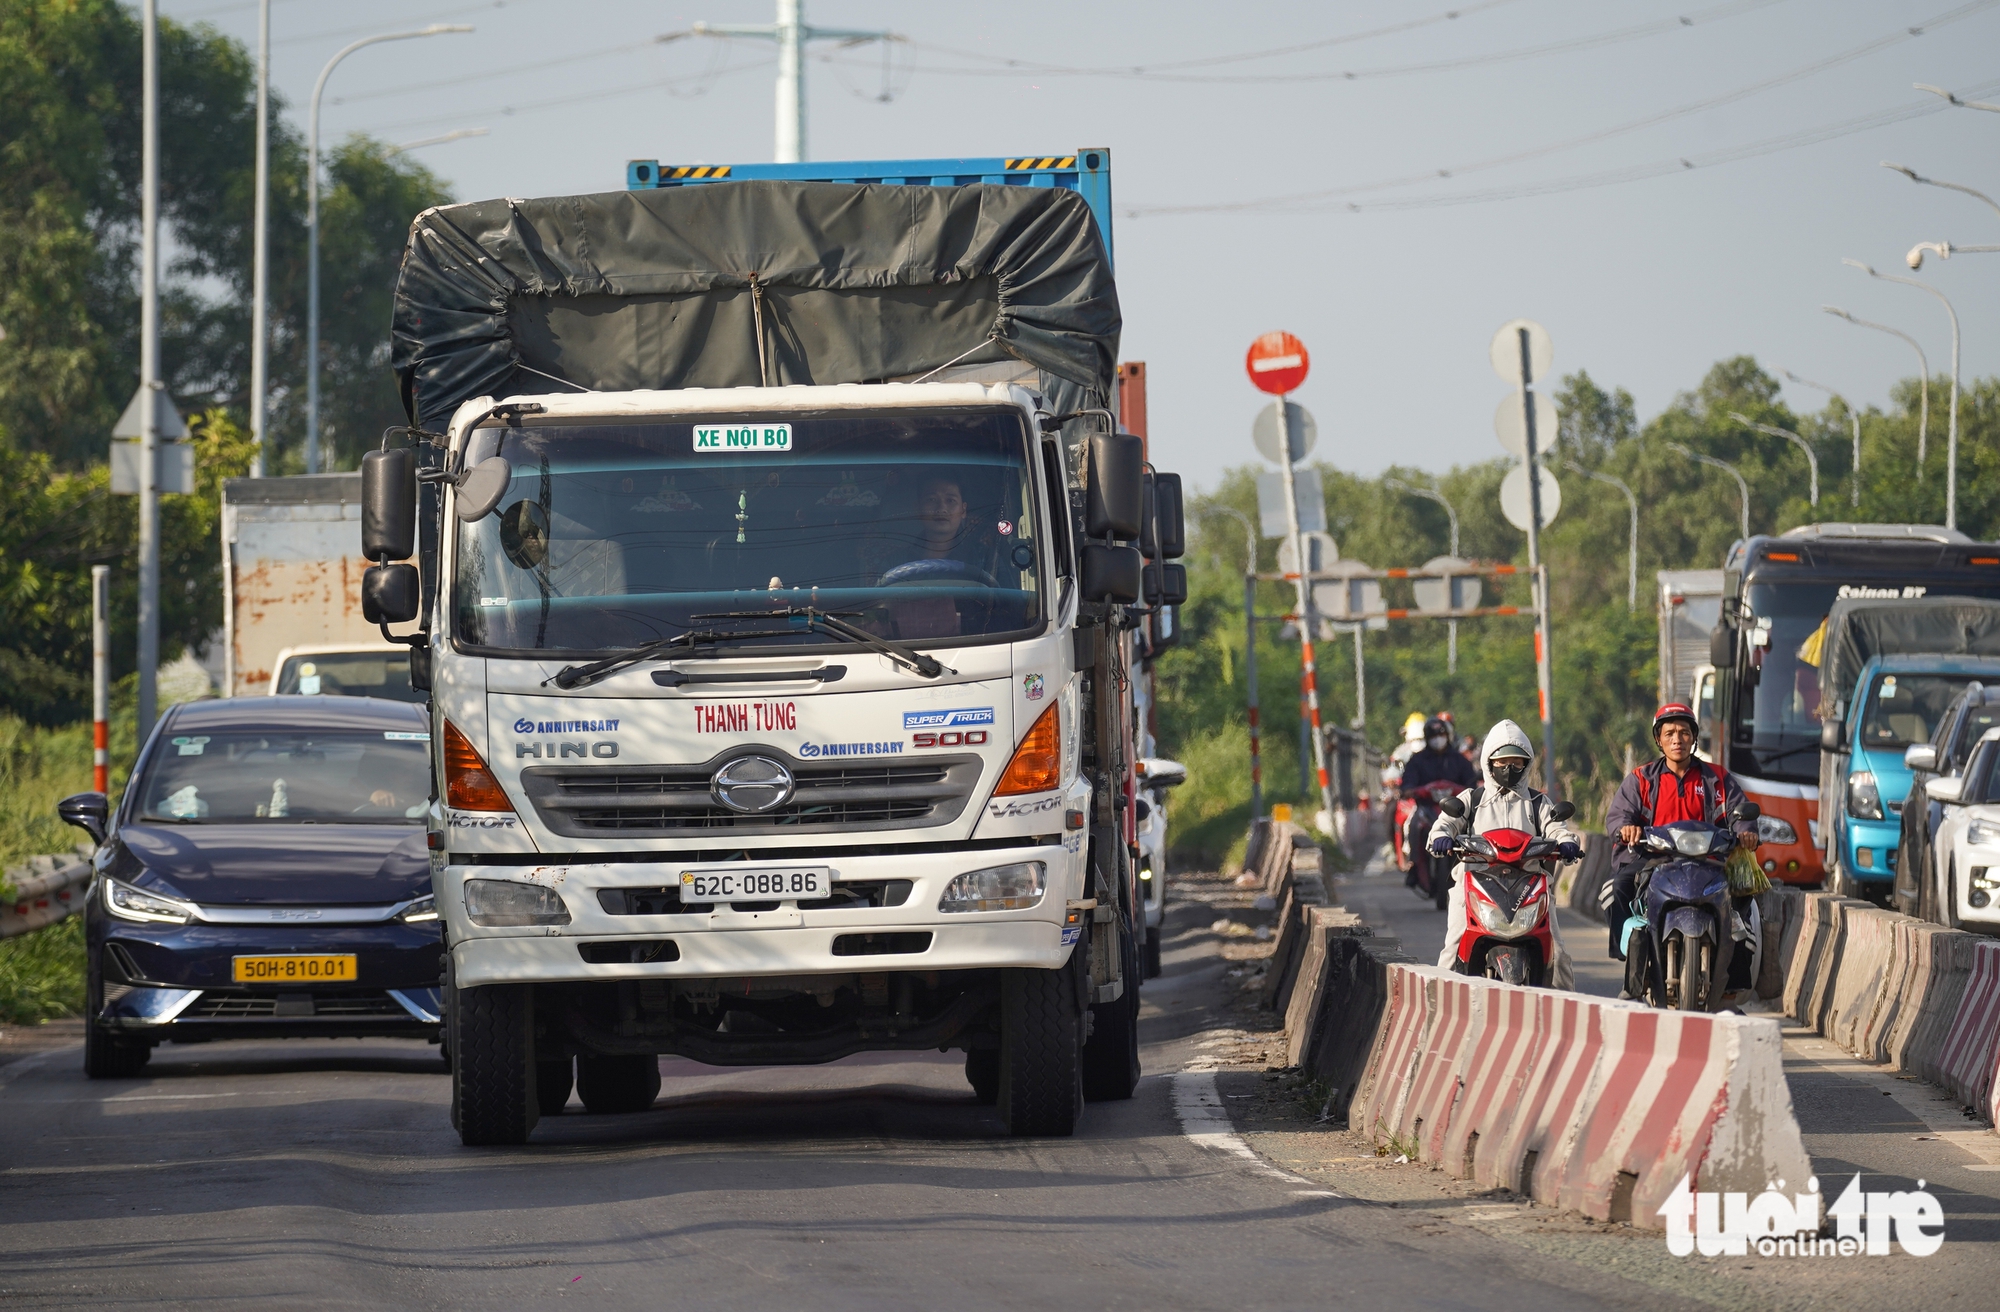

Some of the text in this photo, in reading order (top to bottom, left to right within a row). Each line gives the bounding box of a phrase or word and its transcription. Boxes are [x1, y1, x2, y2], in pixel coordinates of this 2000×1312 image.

[697, 425, 788, 449] XE NỘI BỘ
[537, 719, 620, 733] ANNIVERSARY
[694, 704, 749, 733] THANH
[906, 712, 993, 725] SUPER TRUCK
[912, 730, 988, 748] 500
[515, 740, 620, 758] HINO
[822, 741, 904, 756] ANNIVERSARY
[693, 873, 817, 896] 62C-088.86
[245, 960, 345, 977] 50H-810.01
